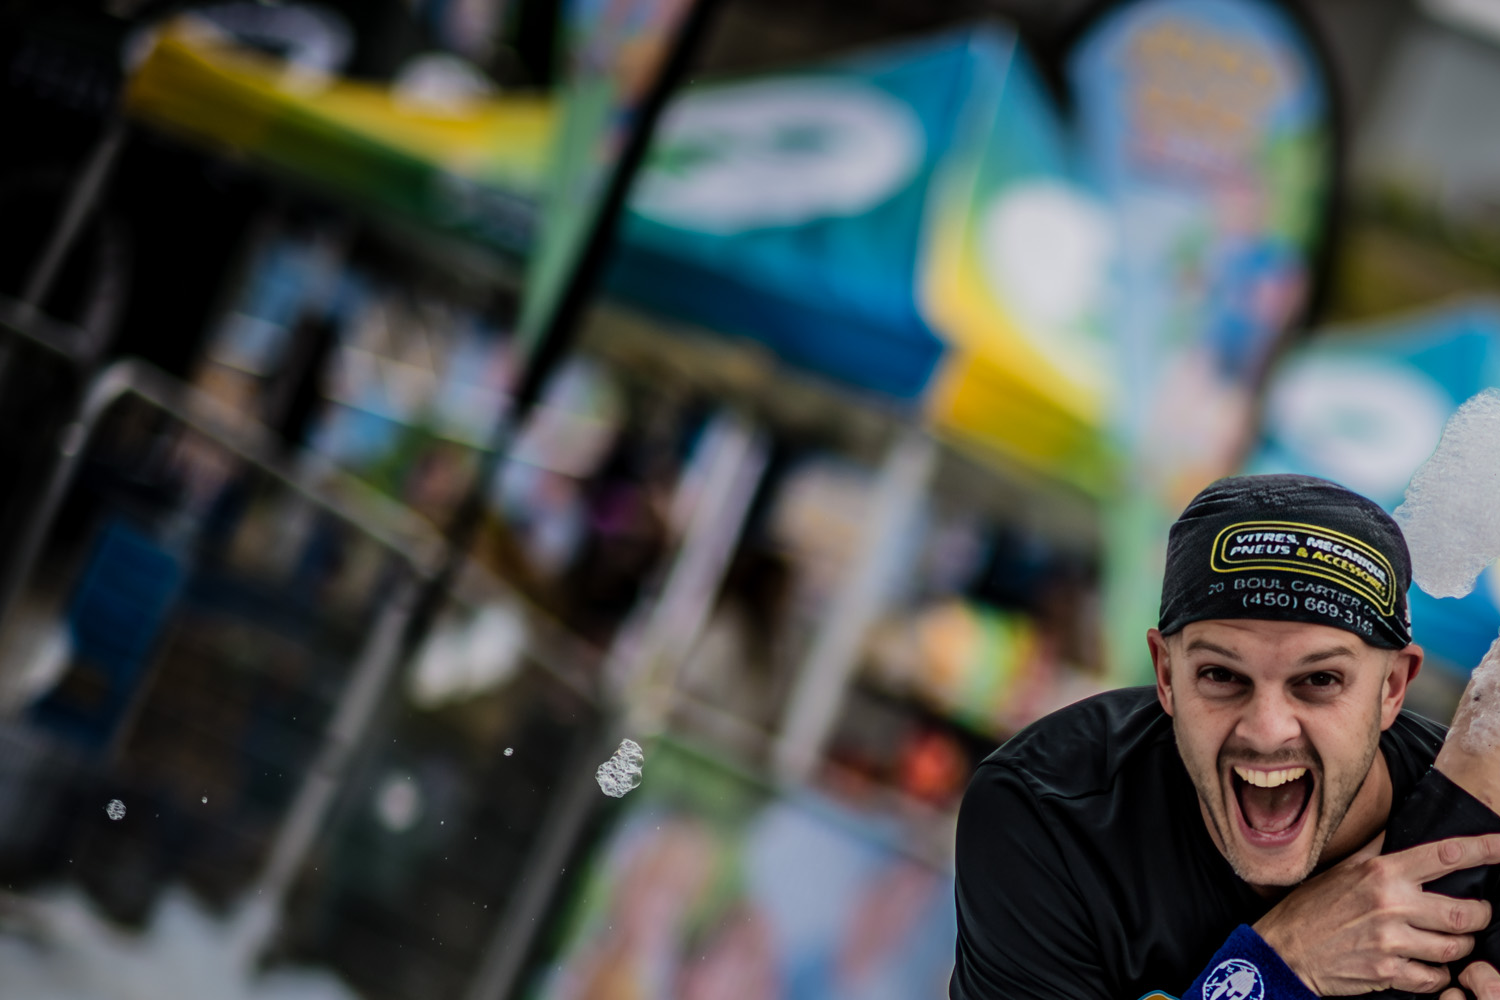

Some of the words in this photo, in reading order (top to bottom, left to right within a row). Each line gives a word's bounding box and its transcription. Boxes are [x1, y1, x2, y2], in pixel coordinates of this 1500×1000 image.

[1229, 544, 1291, 556] PNEUS
[1295, 546, 1309, 558] &
[1233, 577, 1285, 590] BOUL
[1291, 580, 1362, 611] CARTIER
[1242, 592, 1299, 609] (450)
